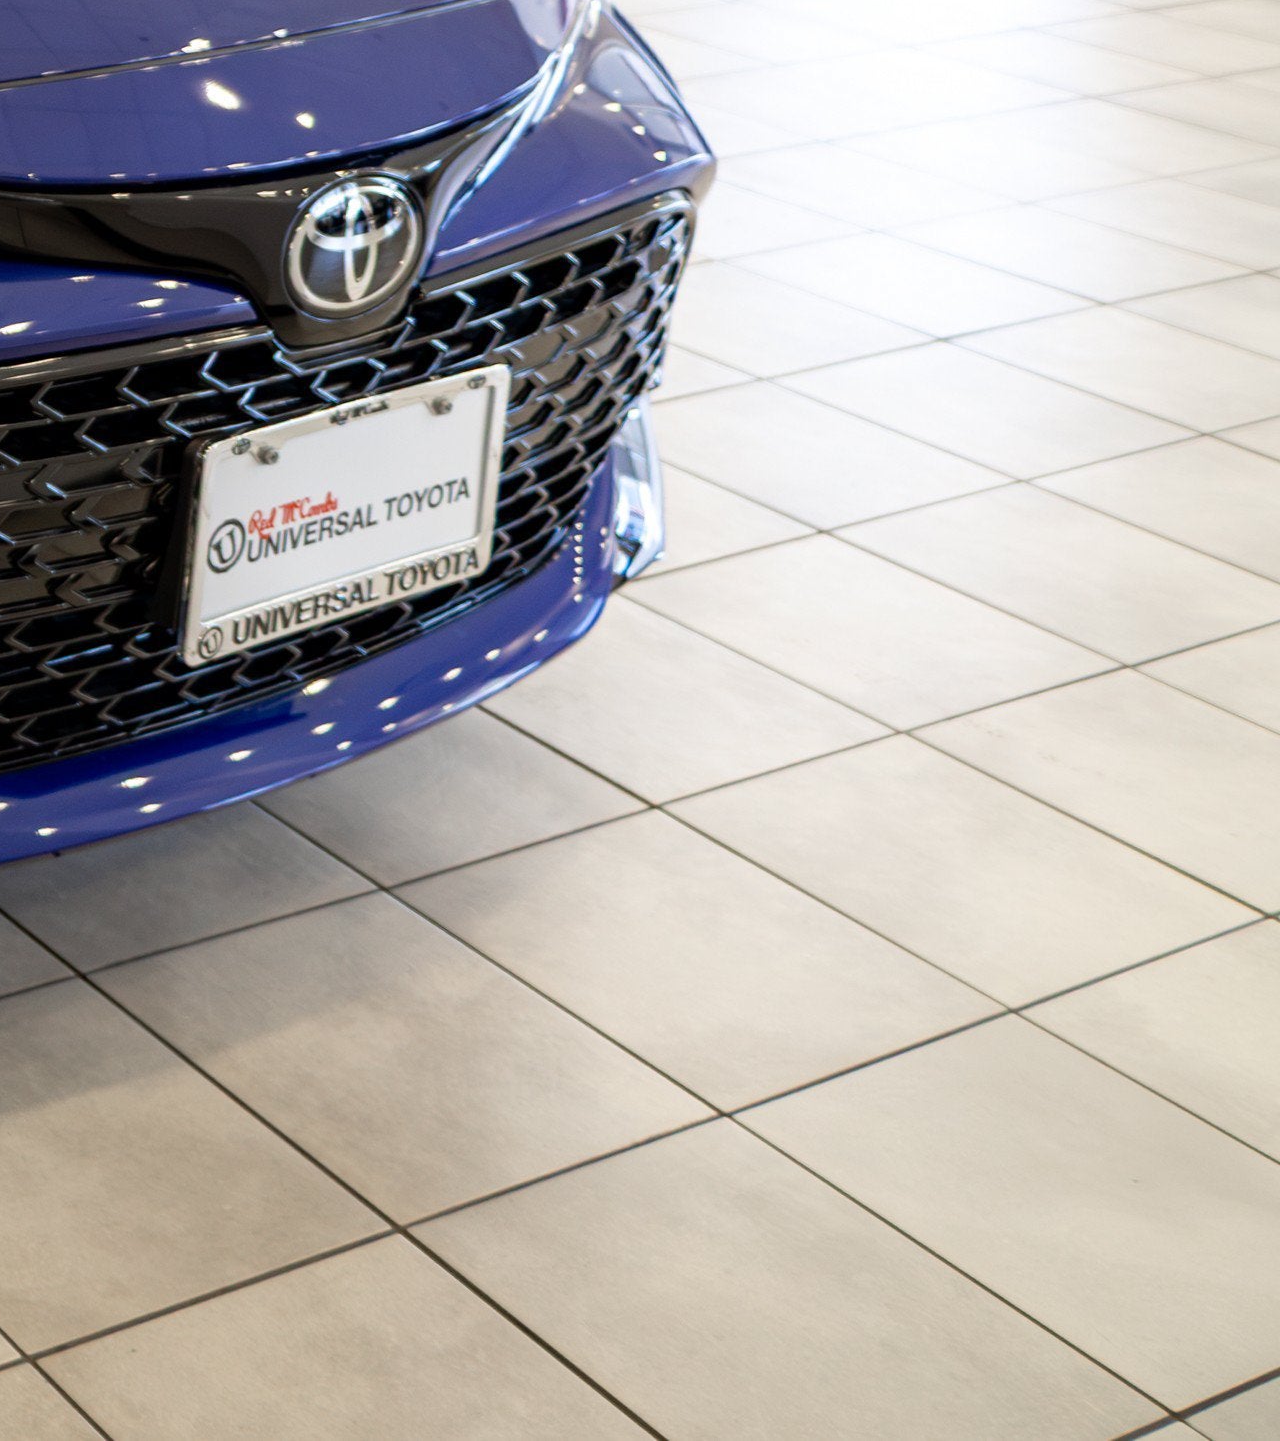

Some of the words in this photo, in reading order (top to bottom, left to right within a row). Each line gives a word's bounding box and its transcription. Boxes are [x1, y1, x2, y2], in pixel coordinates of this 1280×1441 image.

[246, 504, 378, 563] UNIVERSAL
[384, 477, 470, 521] TOYOTA
[248, 507, 276, 540] Red
[232, 577, 380, 645] UNIVERSAL
[386, 548, 479, 596] TOYOTA
